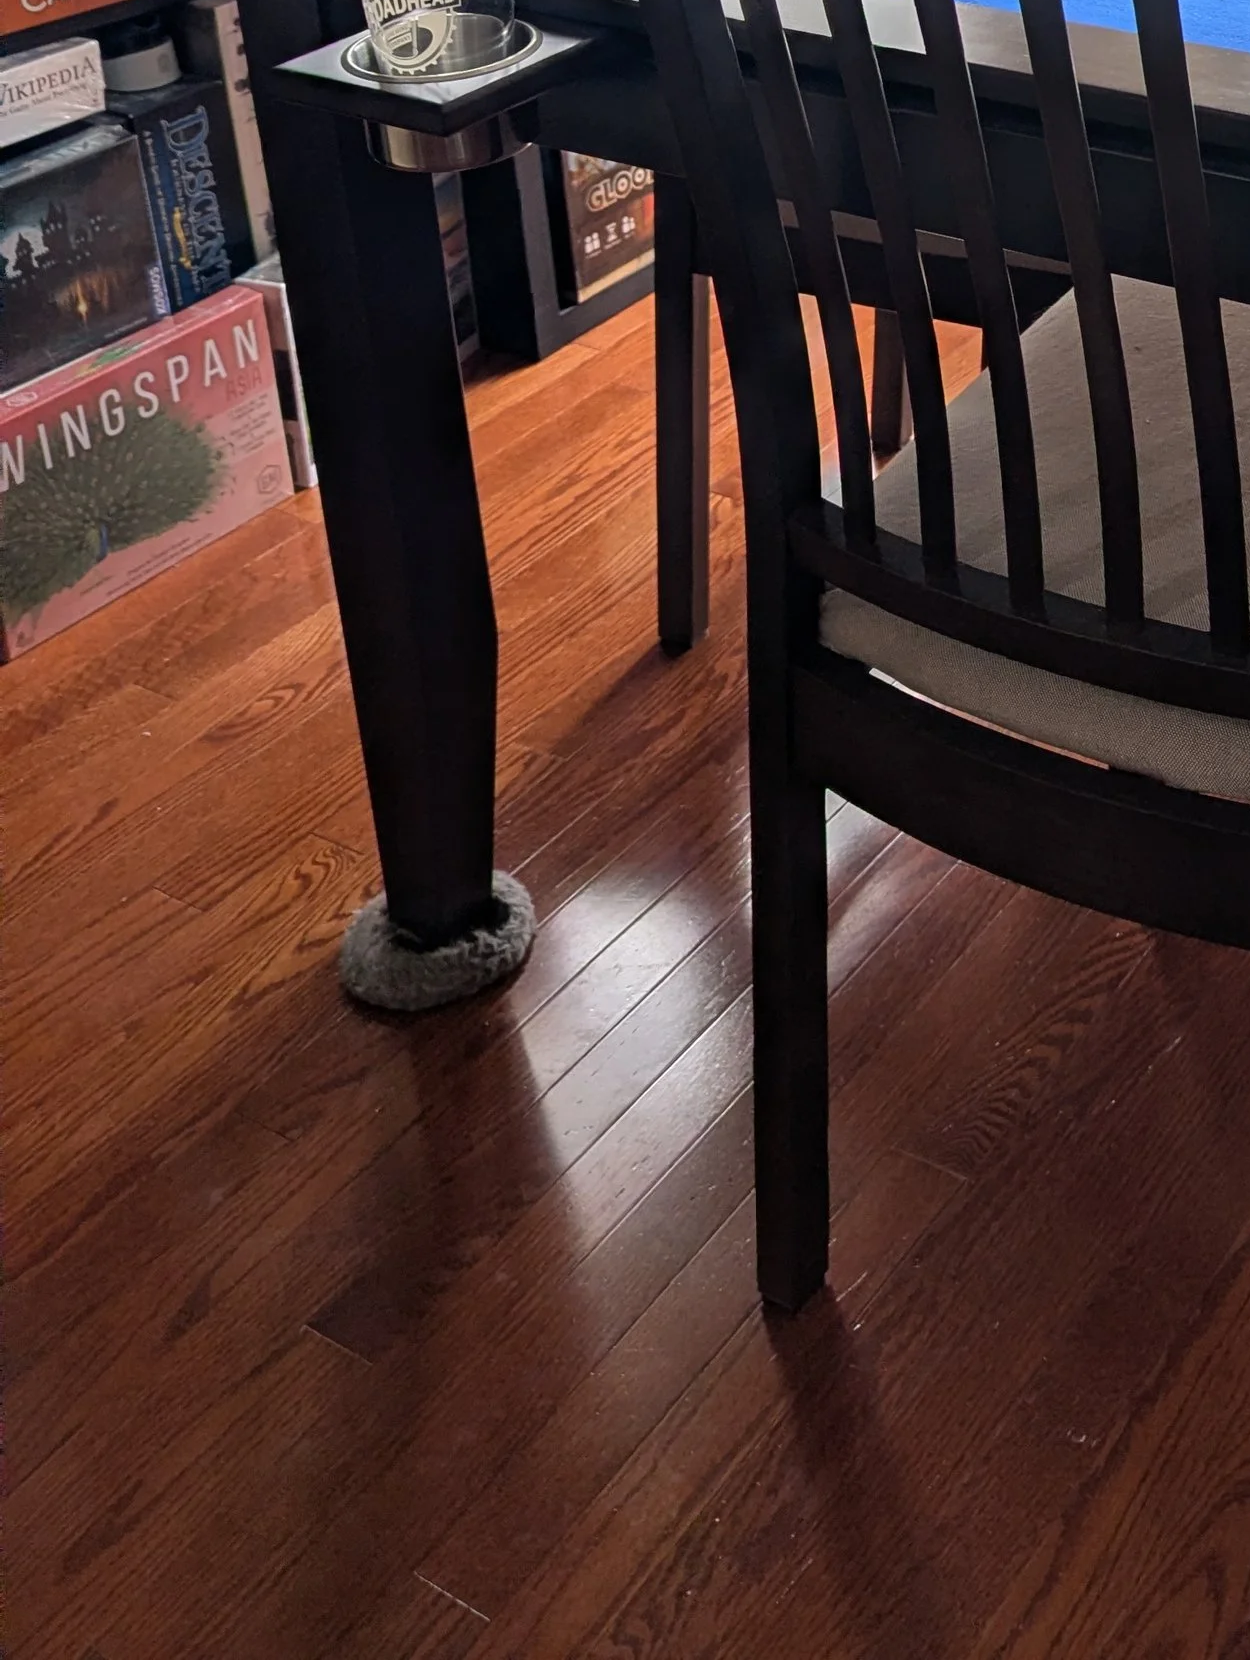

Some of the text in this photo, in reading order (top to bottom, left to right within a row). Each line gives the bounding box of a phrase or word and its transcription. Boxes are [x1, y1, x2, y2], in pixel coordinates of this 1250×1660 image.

[160, 105, 232, 293] DESCENT
[585, 166, 654, 212] GLOO
[150, 266, 167, 315] KOSMOS
[0, 319, 260, 492] WINGSPAN
[225, 365, 262, 401] ASIA
